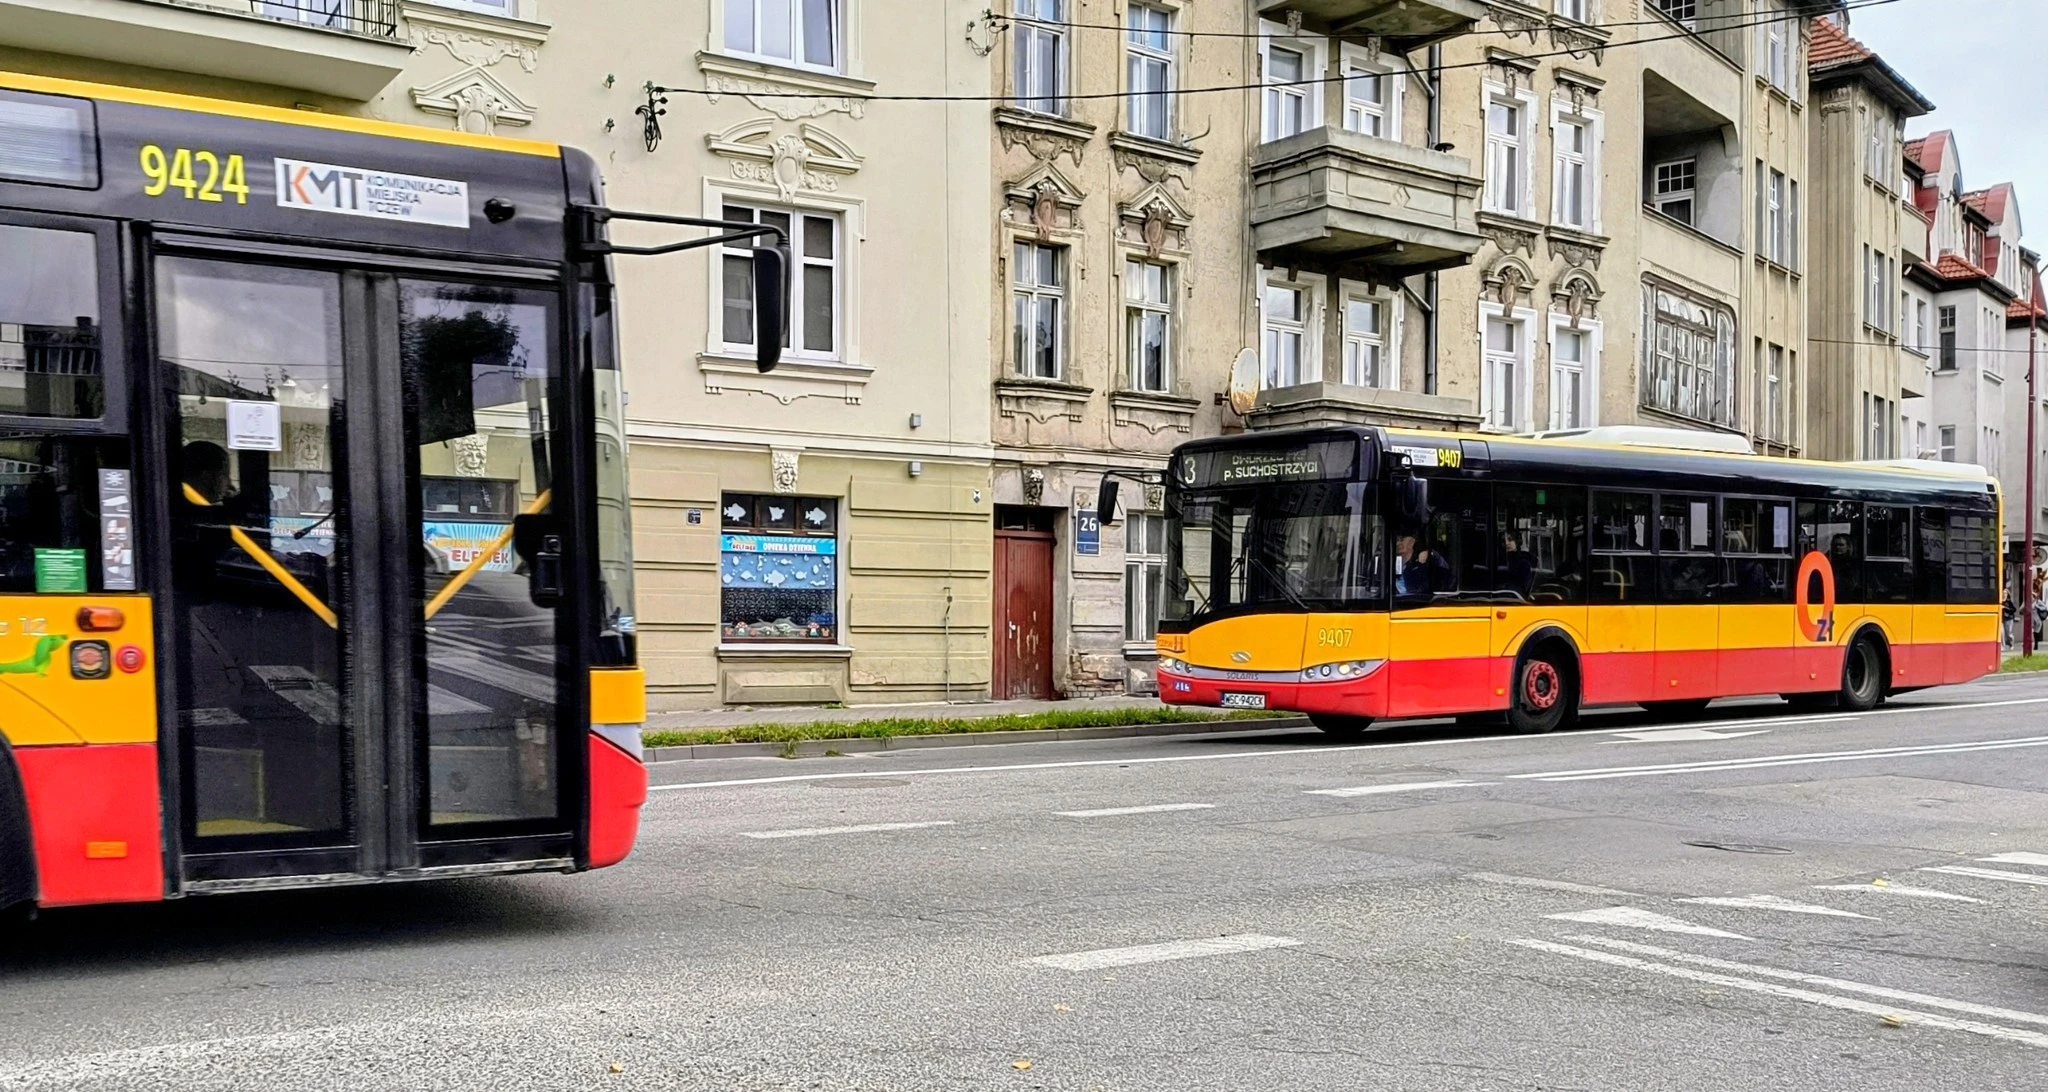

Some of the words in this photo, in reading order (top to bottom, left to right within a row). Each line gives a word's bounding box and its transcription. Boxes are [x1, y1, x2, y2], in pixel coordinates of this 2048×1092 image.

[140, 145, 249, 204] 9424
[282, 163, 363, 210] KMT
[366, 175, 462, 197] KOMUNIKACJA
[366, 187, 422, 206] MIEJSKA
[367, 201, 413, 217] TCZEW
[1438, 448, 1461, 468] 9407
[1184, 456, 1196, 484] 3
[1235, 461, 1318, 479] SUCHOSTRZYGI
[1080, 517, 1097, 532] 26
[18, 617, 49, 636] 12
[1318, 628, 1352, 648] 9407
[1226, 671, 1259, 680] SOLARIS
